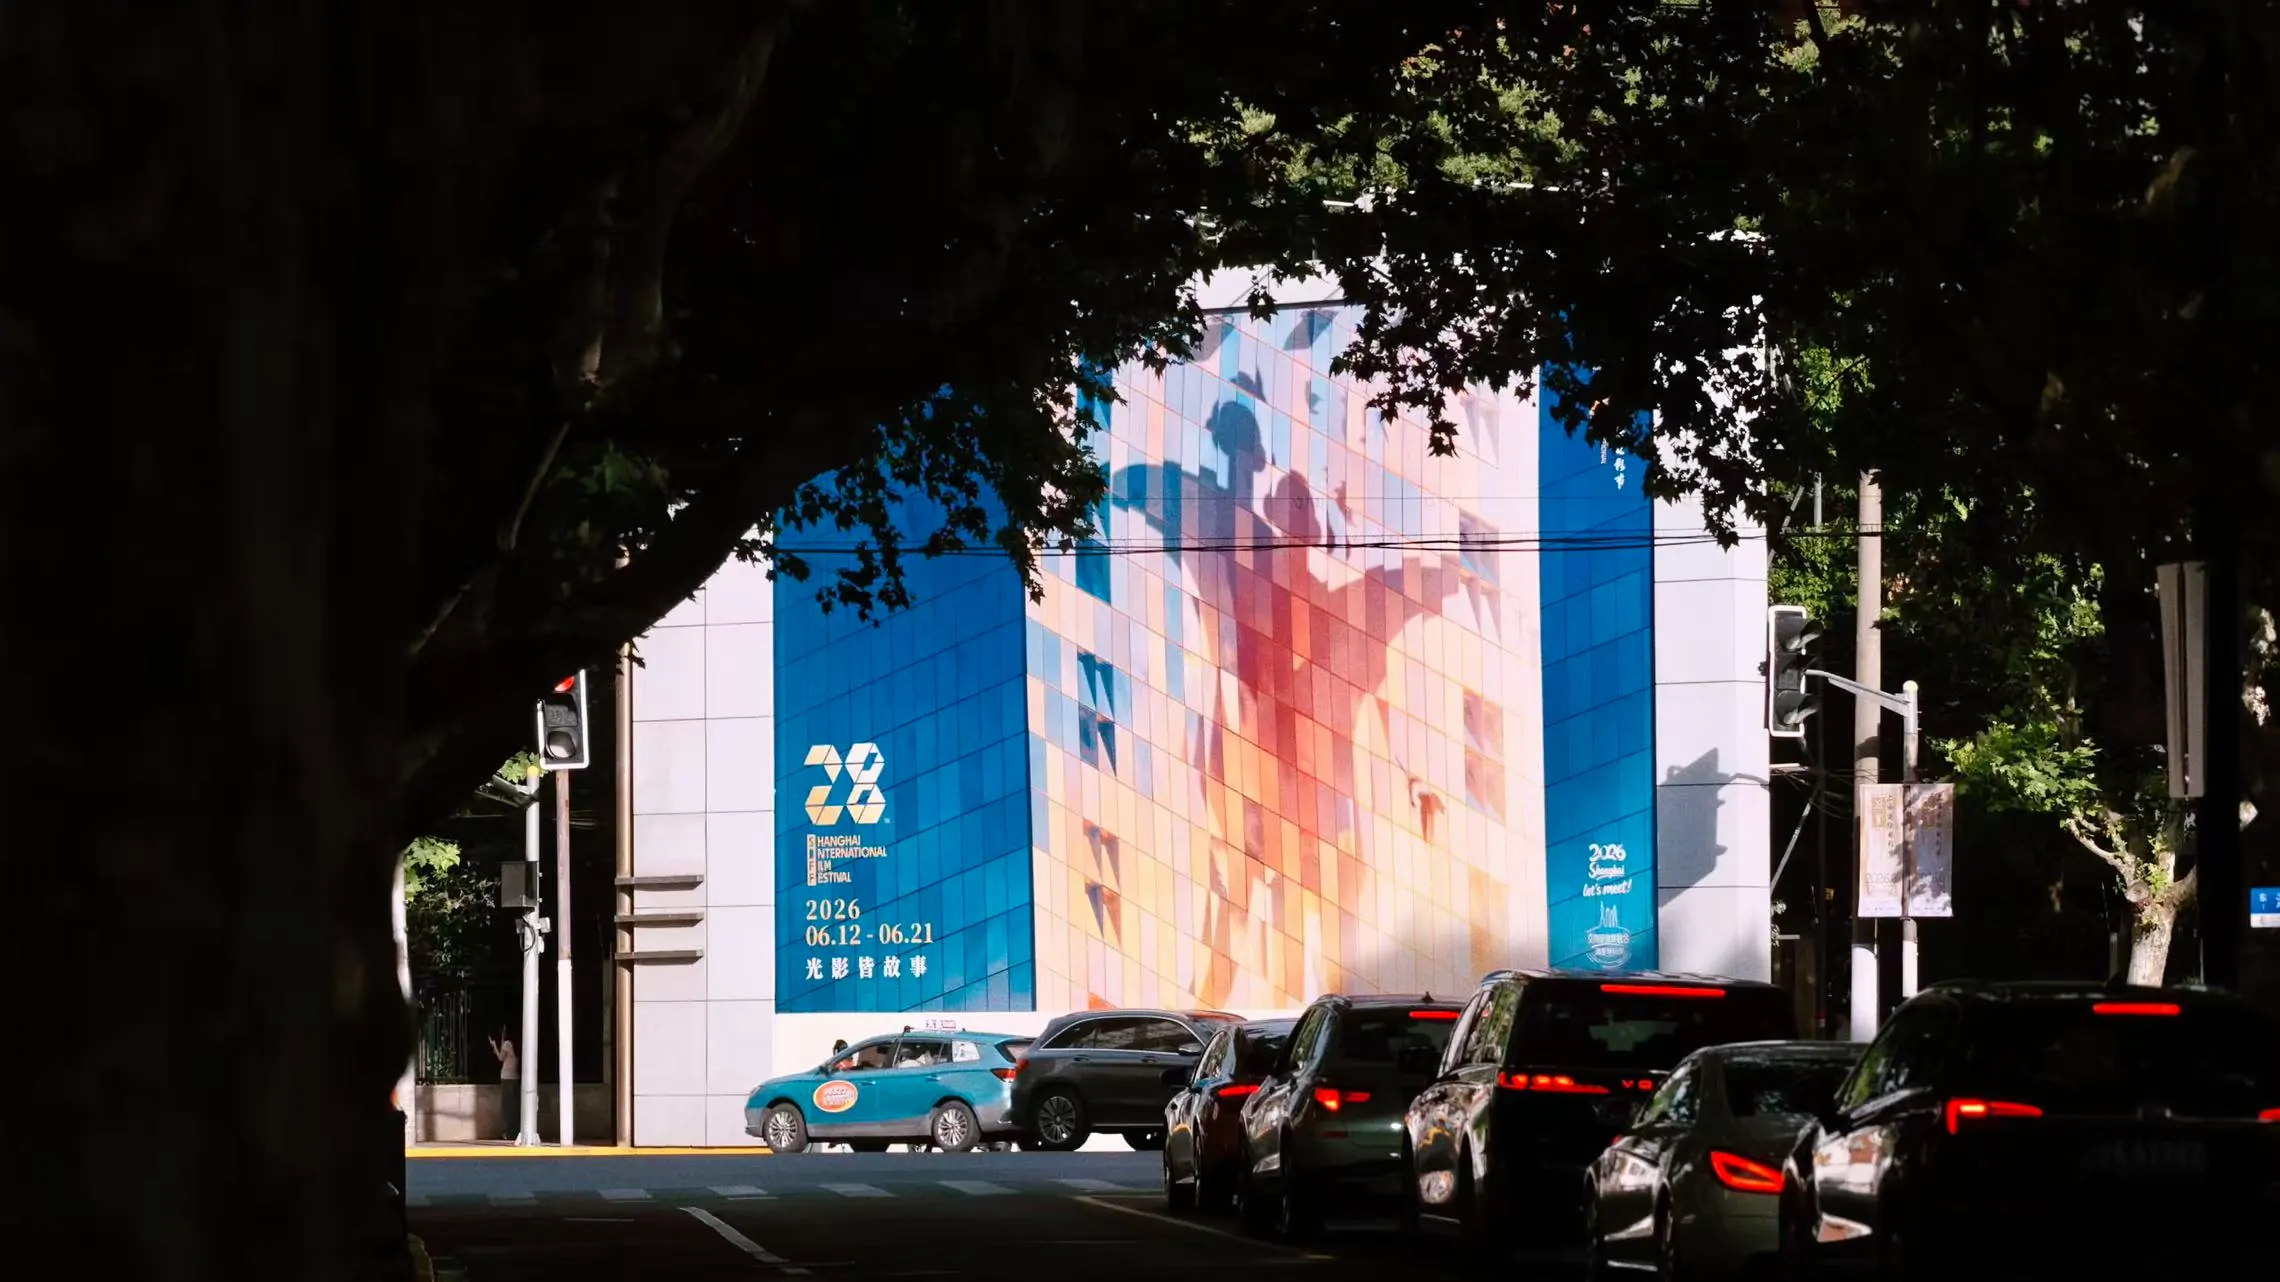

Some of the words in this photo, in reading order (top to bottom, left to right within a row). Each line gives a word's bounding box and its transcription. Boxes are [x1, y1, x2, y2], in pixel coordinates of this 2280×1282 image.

[807, 834, 861, 847] SHANGHAI
[1588, 843, 1627, 861] 2026
[806, 898, 860, 920] 2026
[805, 924, 861, 946] 06.12
[879, 922, 933, 944] 06.21
[805, 955, 927, 980] 光影皆故事
